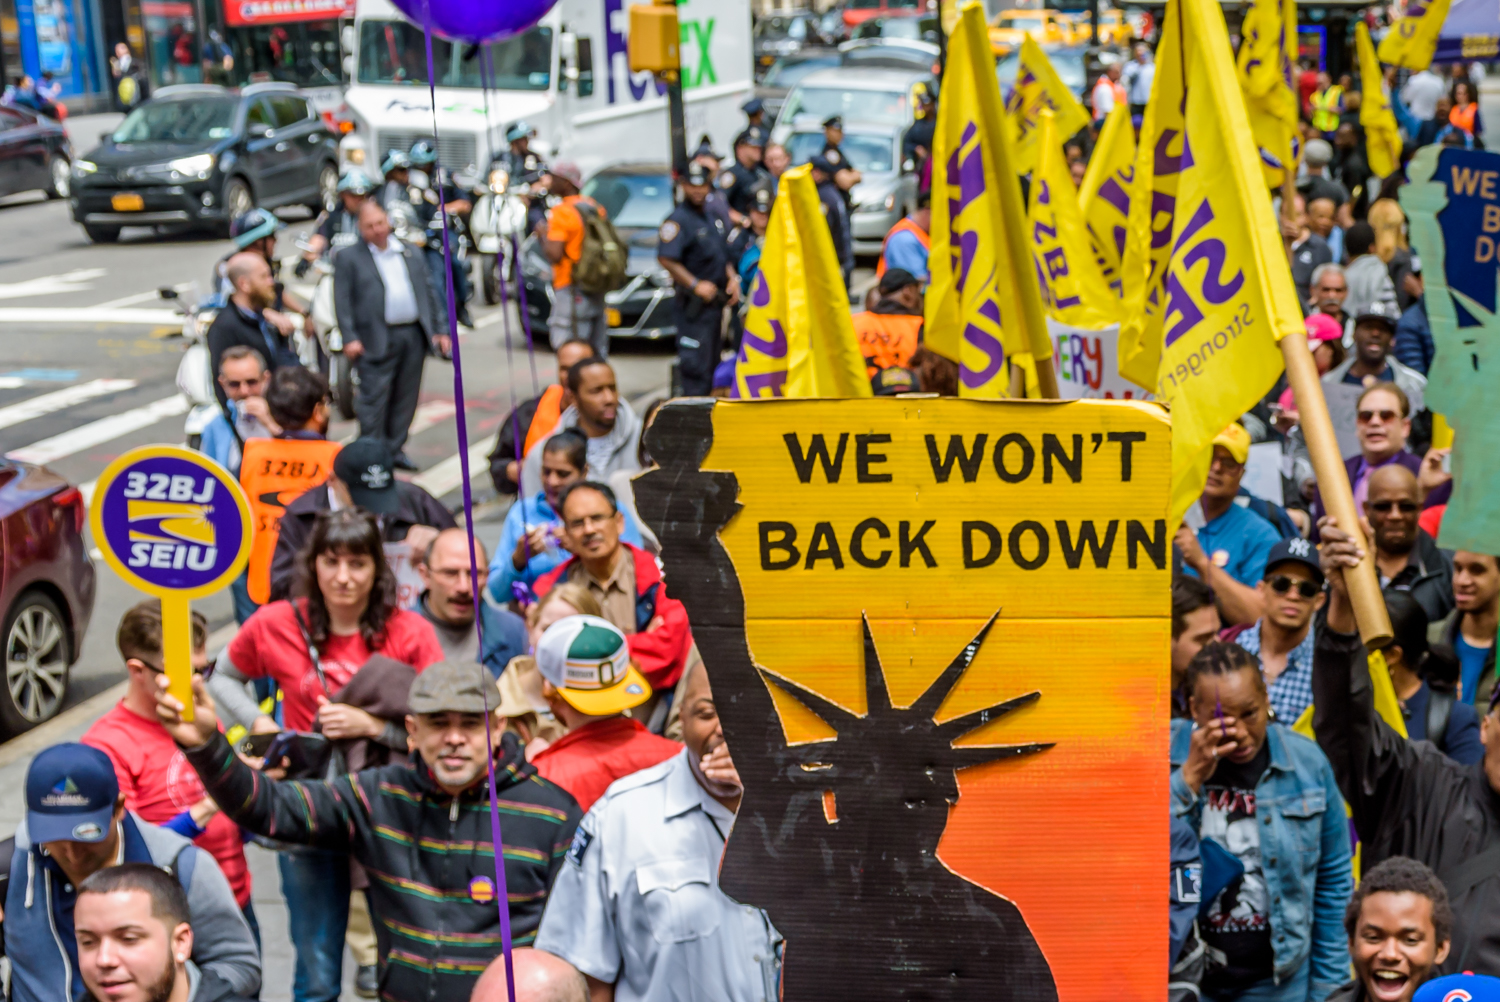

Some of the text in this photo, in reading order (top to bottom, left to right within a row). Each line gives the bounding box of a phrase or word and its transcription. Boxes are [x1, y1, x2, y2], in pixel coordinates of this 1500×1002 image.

[1451, 165, 1499, 199] WE
[783, 430, 1147, 485] WE WON'T
[124, 471, 216, 504] 32BJ
[128, 542, 218, 571] SEIU
[758, 517, 1167, 572] BACK DOWN
